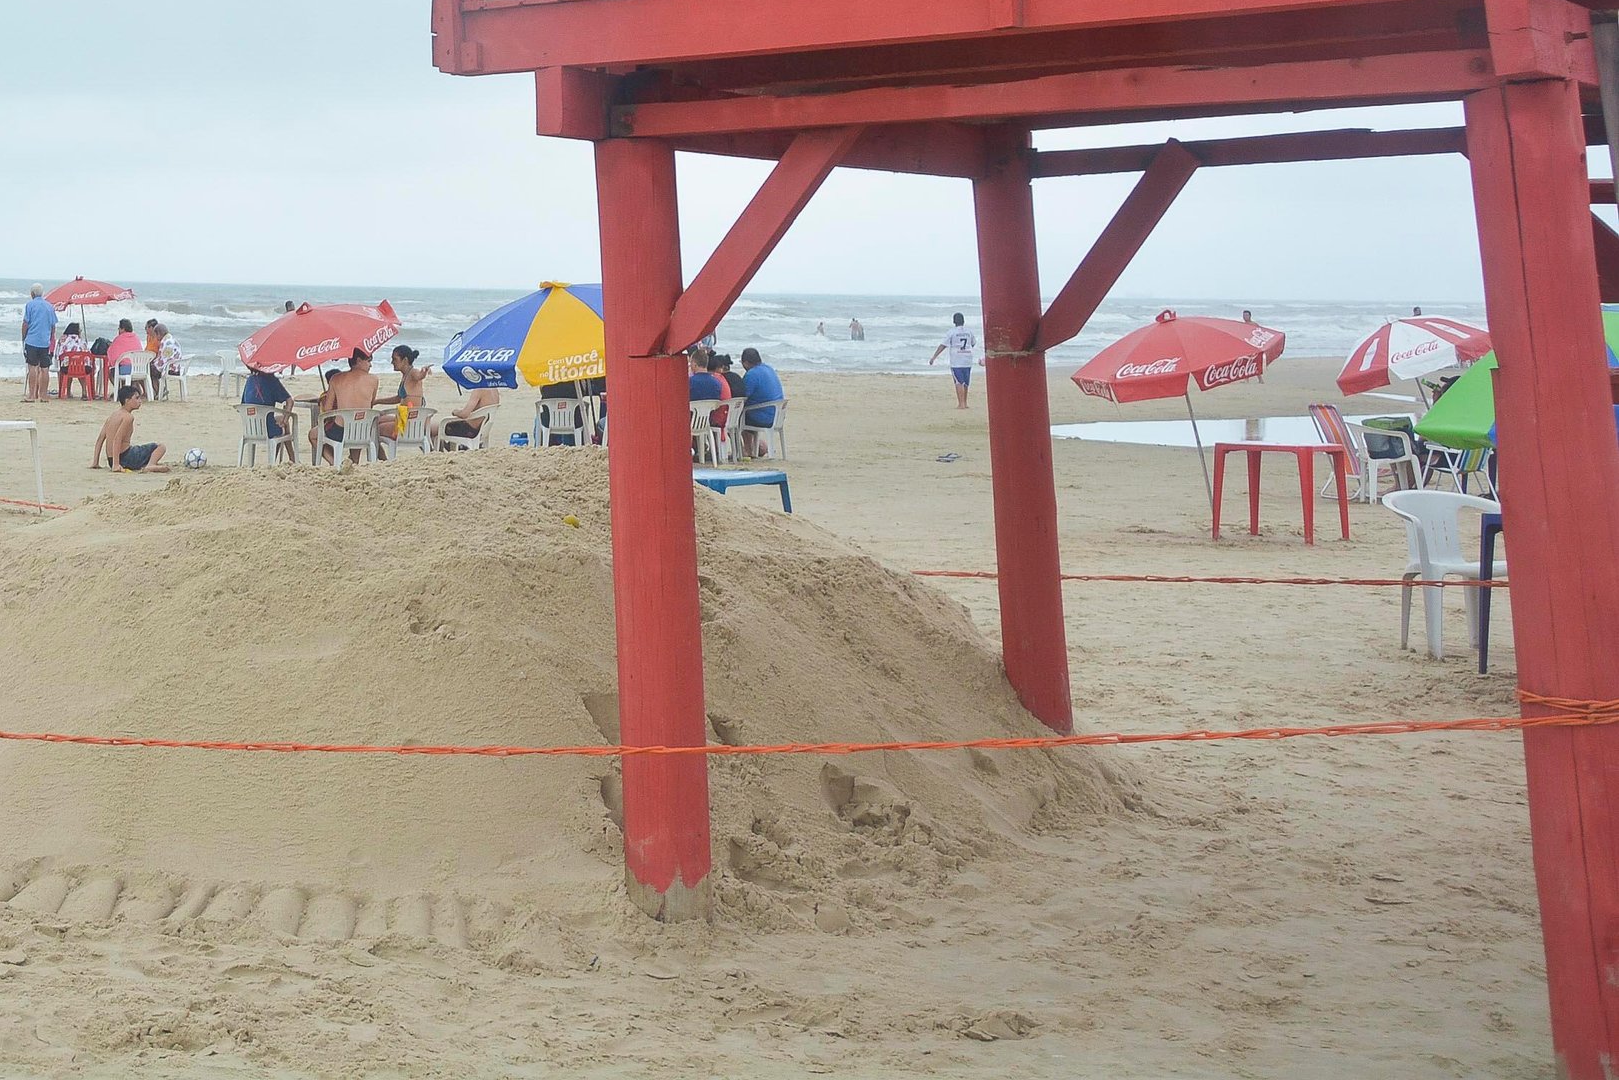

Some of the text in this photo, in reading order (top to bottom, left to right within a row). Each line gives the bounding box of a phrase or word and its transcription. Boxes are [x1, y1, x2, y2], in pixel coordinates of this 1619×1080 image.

[296, 337, 342, 360] Coca-Cola
[455, 348, 516, 363] BECKER
[959, 338, 968, 351] 7
[565, 348, 598, 366] você
[1115, 356, 1181, 379] Coca-Cola
[548, 358, 604, 383] litoral
[1202, 353, 1258, 388] Coca-Cola
